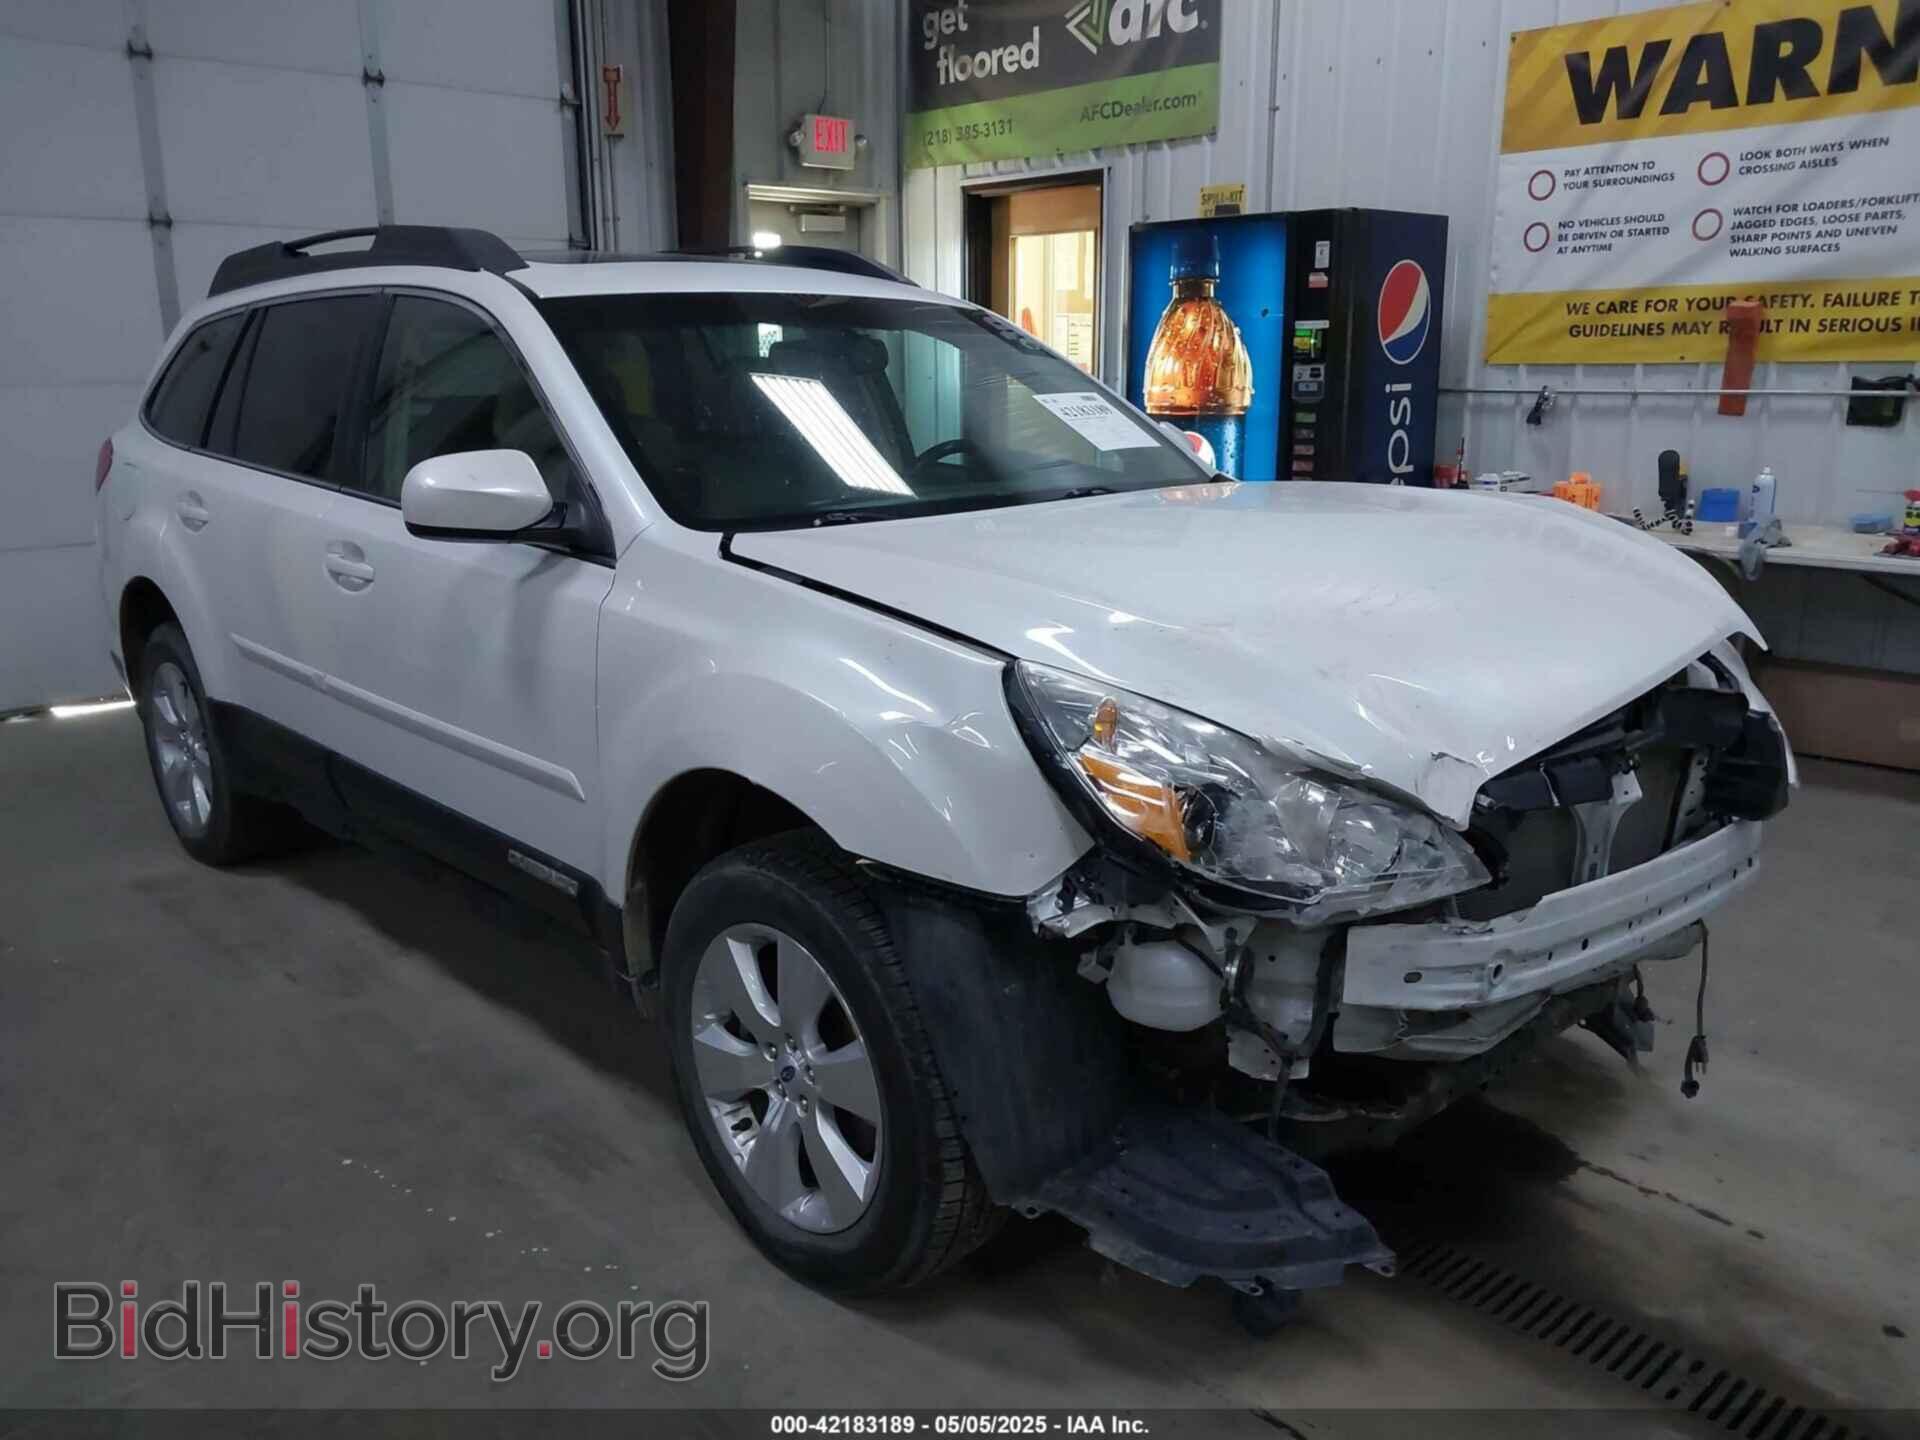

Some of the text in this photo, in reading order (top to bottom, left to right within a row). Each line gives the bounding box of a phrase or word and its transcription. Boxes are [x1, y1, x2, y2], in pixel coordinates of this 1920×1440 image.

[923, 0, 968, 50] get
[937, 25, 1039, 85] floored
[1565, 0, 1920, 125] WARN
[1080, 94, 1197, 122] AFCDealer.com
[815, 118, 848, 152] EXIT
[922, 126, 952, 146] (218)
[1739, 136, 1889, 162] LOOK BOTH WAYS WHEN
[1564, 160, 1655, 178] PAY ATTENTION TO
[1739, 156, 1838, 175] CROSSING AISLES
[1563, 172, 1675, 191] YOUR SURROUNDINGS
[1733, 192, 1920, 217] WATCH FOR LOADERS/FORKLIFT
[1558, 213, 1665, 230] NO VEHICLES SHOULD
[1730, 209, 1906, 231] JAGGED EDGES, LOOSE PARTS,
[1558, 226, 1670, 242] BE DRIVEN OR STARTED
[1730, 225, 1898, 244] SHARP POINTS AND UNEVEN
[1557, 243, 1613, 255] AT ANYTIME
[1729, 242, 1841, 257] WALKING SURFACES
[1566, 302, 1591, 316] WE
[1596, 299, 1639, 314] CARE
[1645, 298, 1679, 313] FOR
[1823, 290, 1901, 308] FAILURE
[1910, 290, 1920, 305] T
[1569, 322, 1665, 338] GUIDELINES
[1671, 320, 1712, 335] MAY
[1719, 319, 1783, 335] RLT
[1789, 318, 1811, 332] IN
[1818, 317, 1903, 333] SERIOUS
